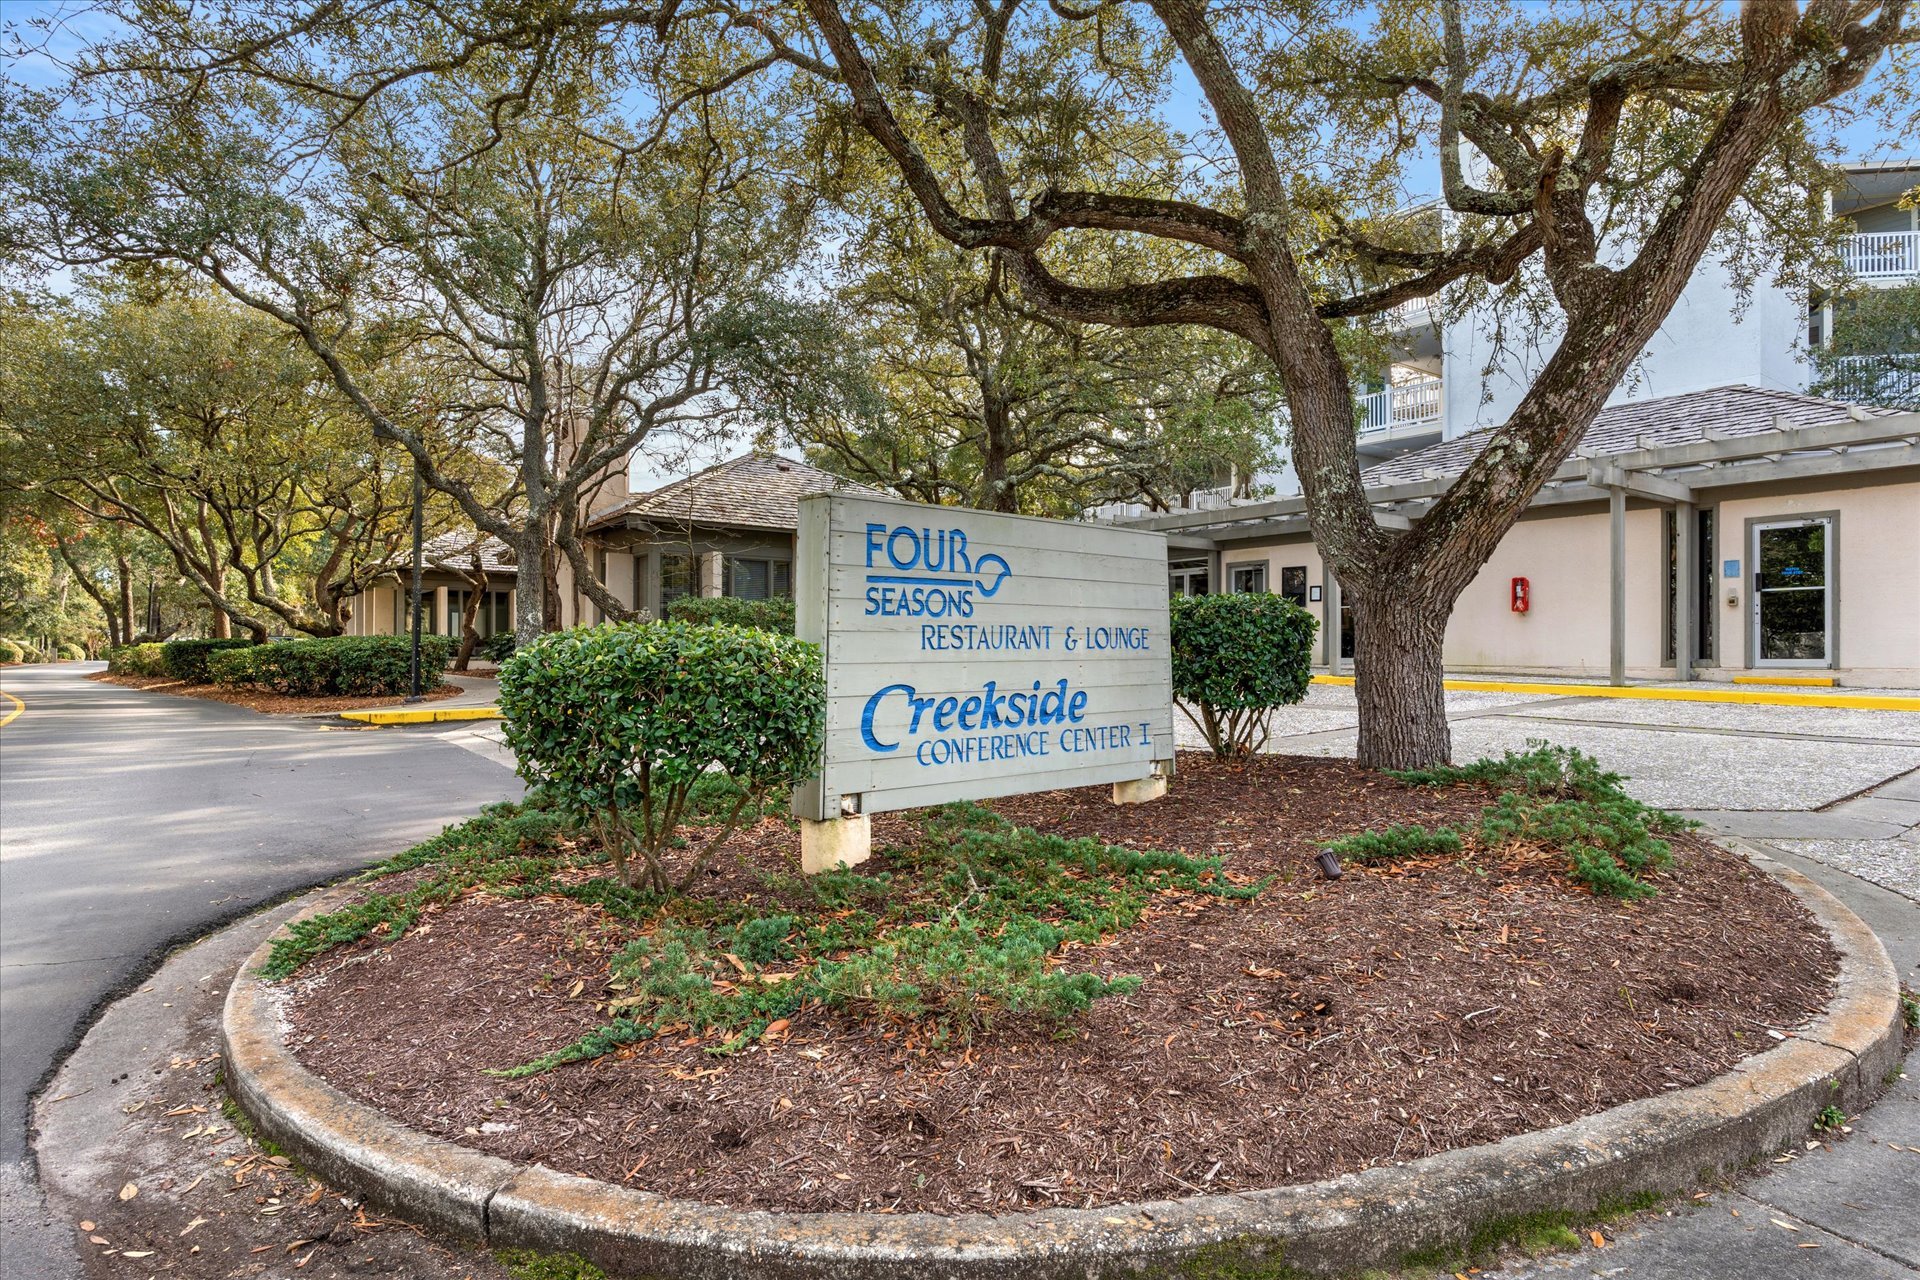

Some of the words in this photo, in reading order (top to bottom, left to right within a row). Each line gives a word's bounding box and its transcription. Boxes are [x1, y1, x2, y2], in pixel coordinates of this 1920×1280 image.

[865, 523, 972, 574] FOUR
[864, 586, 974, 618] SEASONS
[921, 624, 1053, 650] RESTAURANT
[1064, 627, 1079, 651] &
[1086, 626, 1150, 650] LOUNGE
[860, 678, 1088, 753] Creekside
[916, 731, 1049, 767] CONFERENCE
[1059, 725, 1131, 753] CENTER
[1138, 723, 1151, 746] I
